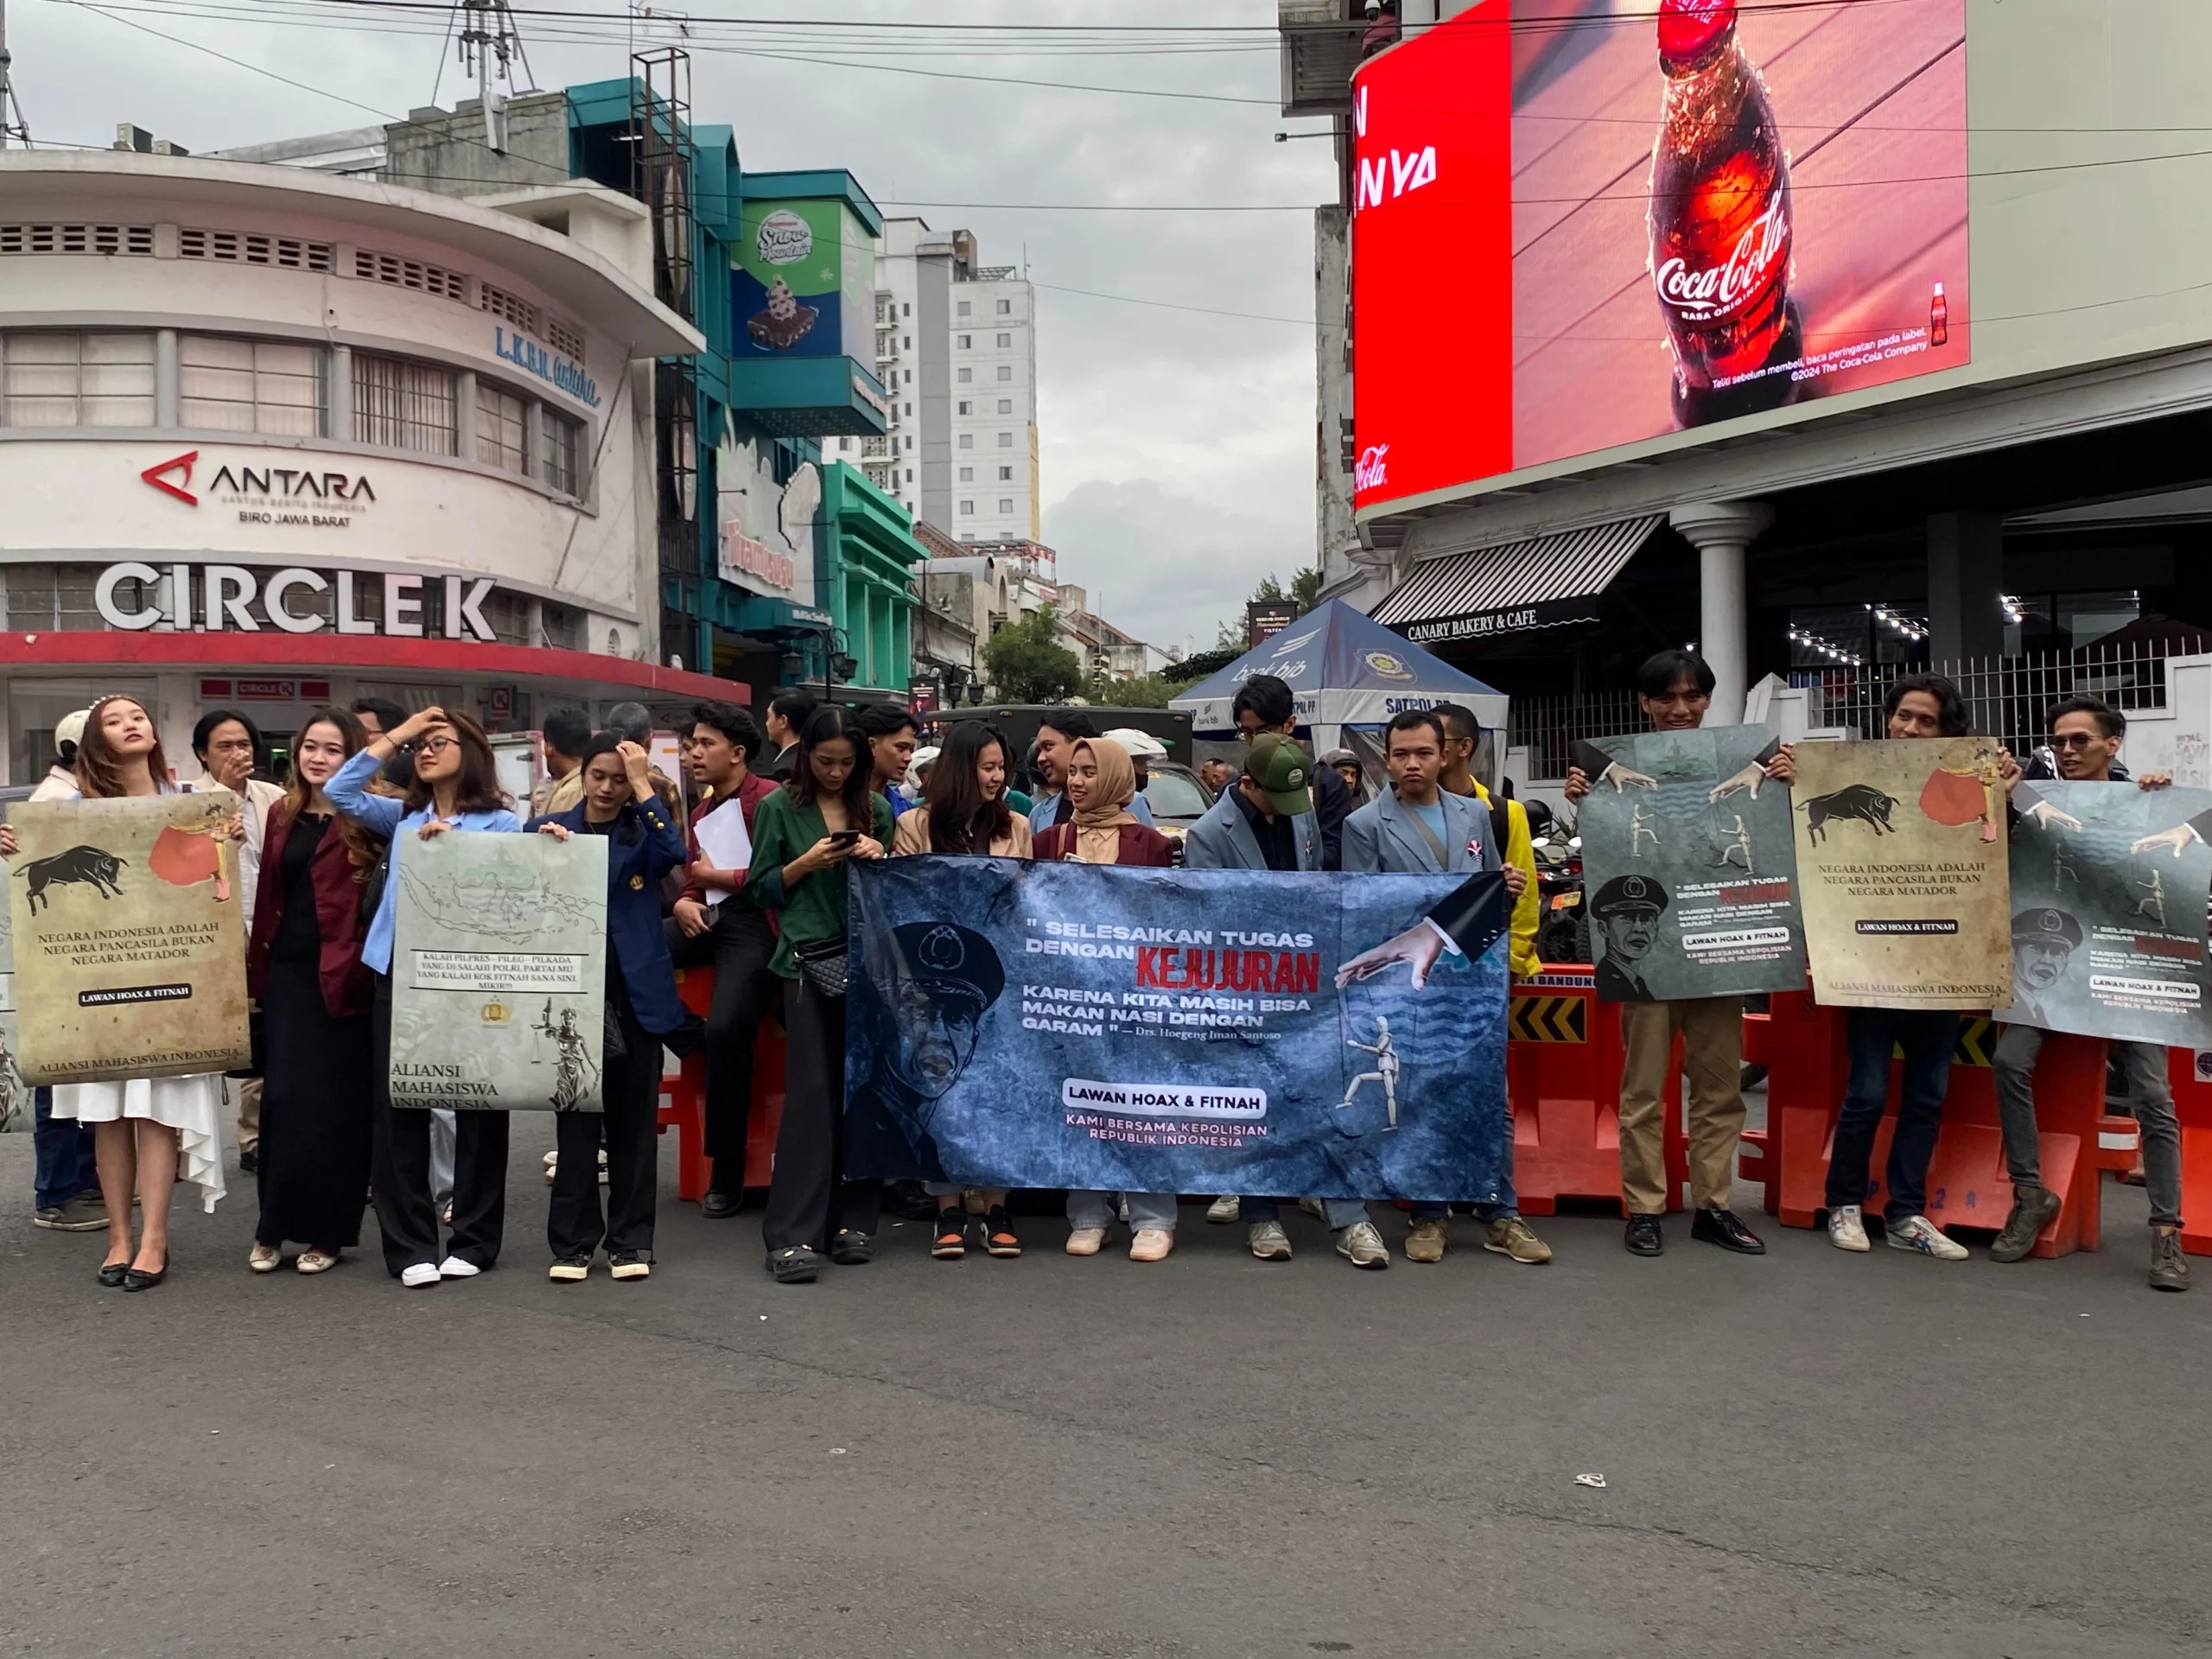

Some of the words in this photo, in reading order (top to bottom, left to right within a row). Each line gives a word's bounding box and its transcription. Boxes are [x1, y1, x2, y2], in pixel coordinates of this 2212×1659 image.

[758, 229, 809, 250] Snow
[1656, 176, 1788, 310] Coca-Cola
[758, 243, 811, 263] Mountain
[1681, 311, 1712, 321] RASA
[1714, 274, 1767, 317] ORIGINAL
[1732, 369, 1765, 385] sebelum
[1806, 353, 1827, 365] baca
[1828, 341, 1875, 364] peringatan
[1877, 334, 1900, 349] pada
[1902, 327, 1927, 340] label.
[1791, 368, 1820, 382] ©2024
[1822, 364, 1838, 375] The
[1840, 352, 1883, 370] Coca-Cola
[1884, 341, 1928, 359] Company
[210, 465, 377, 501] ANTARA
[239, 511, 271, 524] BIRO
[275, 514, 309, 525] JAWA
[312, 516, 351, 527] BARAT
[94, 562, 423, 638] CIRCLE
[441, 574, 498, 641] K
[1408, 622, 1451, 641] CANARY
[1452, 614, 1495, 636] BAKERY
[1497, 614, 1505, 628] &
[1507, 609, 1536, 626] CAFE
[1274, 659, 1307, 681] bjb
[239, 683, 276, 693] CIRCLE
[1818, 865, 1865, 874] NEGARA
[1867, 864, 1933, 874] INDONESIA
[1936, 862, 1986, 872] ADALAH
[1823, 875, 1869, 885] NEGARA
[1872, 874, 1937, 885] PANCASILA
[1940, 874, 1981, 883] BUKAN
[1848, 887, 1894, 896] NEGARA
[1897, 887, 1958, 896] MATADOR
[38, 931, 91, 944] NEGARA
[93, 926, 164, 940] INDONESIA
[168, 922, 219, 934] ADALAH
[1045, 921, 1212, 946] SELESAIKAN
[1220, 931, 1313, 948] TUGAS
[44, 944, 96, 956] NEGARA
[99, 938, 168, 952] PANCASILA
[172, 935, 215, 946] BUKAN
[72, 956, 124, 966] NEGARA
[126, 949, 190, 962] MATADOR
[1026, 938, 1134, 961] DENGAN
[1136, 945, 1320, 994] KEJUJURAN
[1538, 976, 1596, 987] BANDUN
[1829, 982, 1869, 992] ALIANSI
[1871, 984, 1936, 994] MAHASISWA
[2093, 979, 2126, 988] LAWAN
[81, 993, 116, 1003] LAWAN
[117, 991, 143, 1000] HOAX
[153, 987, 188, 997] FITNAH
[1023, 984, 1115, 1005] KARENA
[1122, 993, 1171, 1008] KITA
[1179, 995, 1253, 1012] MASIH
[1259, 999, 1311, 1012] BISA
[1022, 1001, 1103, 1020] MAKAN
[1110, 1008, 1162, 1024] NASI
[1169, 1012, 1264, 1027] DENGAN
[1022, 1018, 1102, 1037] GARAM
[1135, 1027, 1156, 1037] Drs.
[1160, 1029, 1206, 1040] Hoegeng
[1210, 1030, 1236, 1039] Iman
[39, 1060, 89, 1073] ALIANSI
[91, 1054, 168, 1069] MAHASISWA
[391, 1063, 460, 1077] ALIANSI
[391, 1081, 499, 1096] MAHASISWA
[1069, 1087, 1126, 1104] LAWAN
[1132, 1094, 1179, 1107] HOAX
[1185, 1096, 1194, 1107] &
[1200, 1096, 1260, 1109] FITNAH
[393, 1097, 491, 1109] INDONESIA
[1066, 1114, 1103, 1127] KAMI
[1108, 1118, 1176, 1132] BERSAMA
[1181, 1122, 1267, 1136] KEPOLISIAN
[1090, 1128, 1156, 1145] REPUBLIK
[1163, 1135, 1243, 1147] INDONESIA
